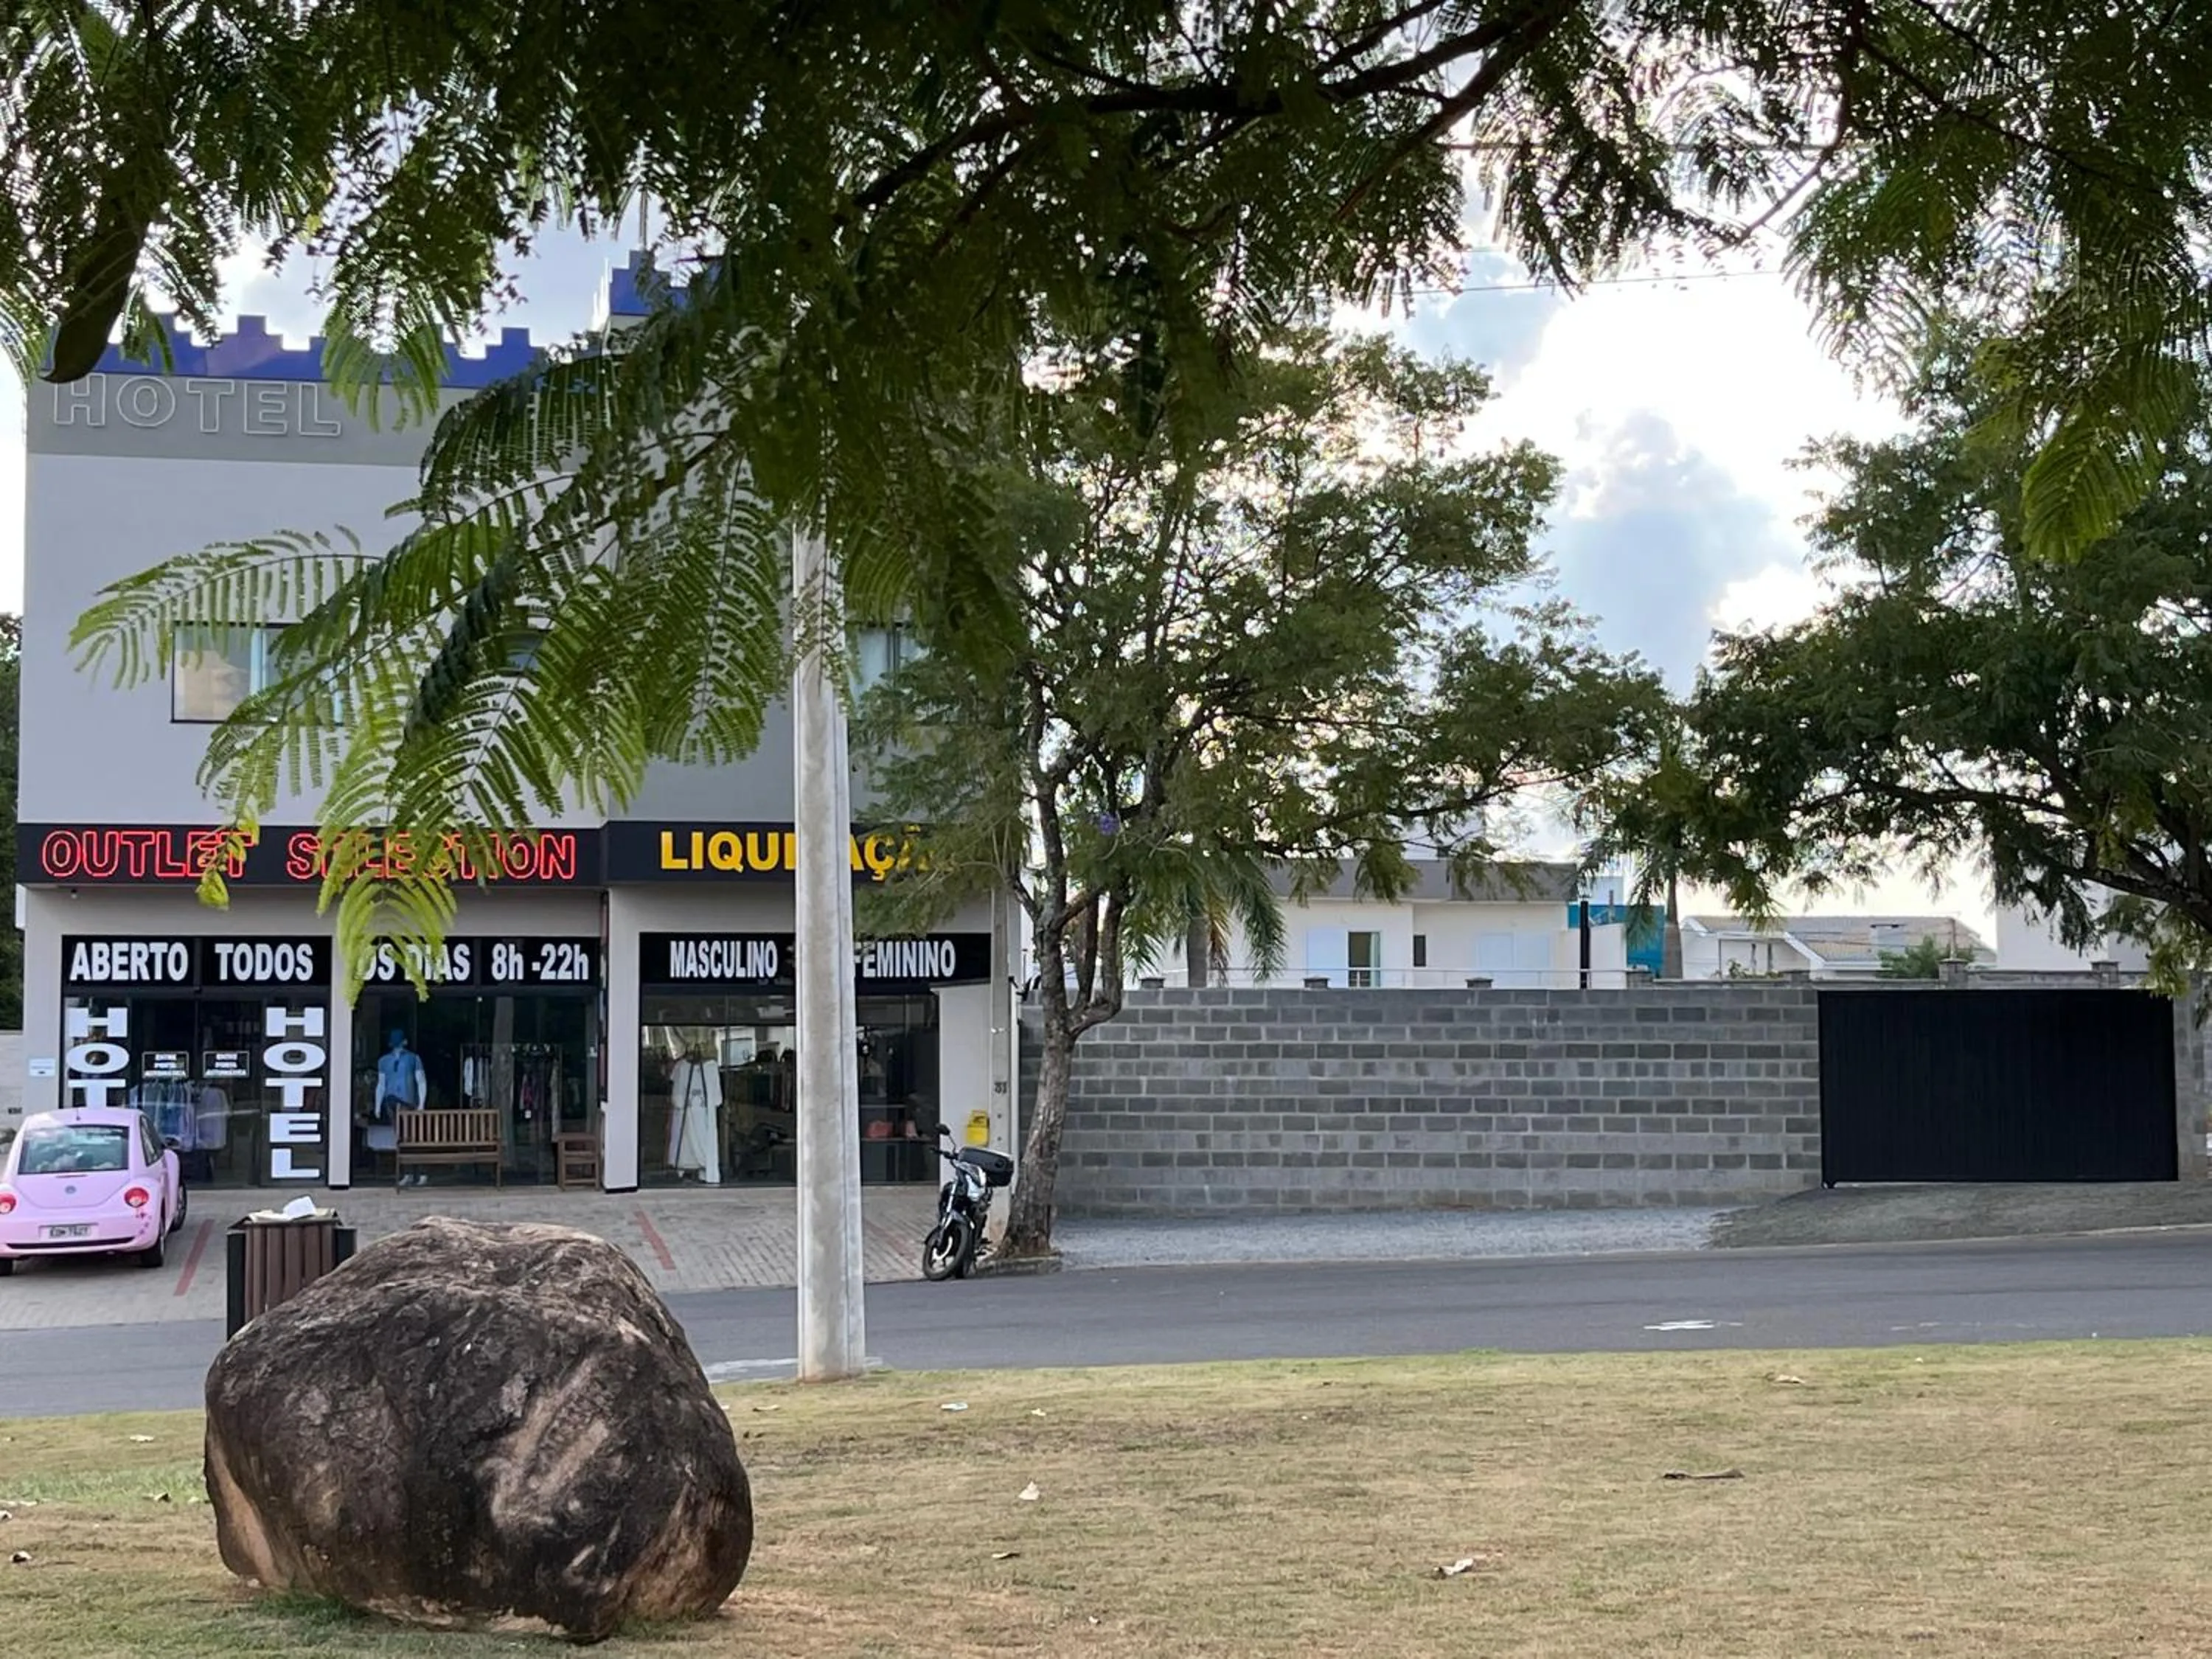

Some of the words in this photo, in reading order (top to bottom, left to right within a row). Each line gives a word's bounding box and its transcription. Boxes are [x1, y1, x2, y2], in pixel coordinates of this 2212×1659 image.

[54, 372, 341, 437] HOTEL
[42, 830, 255, 878] OUTLET
[286, 832, 576, 880] SLETION
[660, 824, 931, 880] LIQUIÇ
[69, 942, 189, 981] ABERTO
[215, 943, 314, 981] TODOS
[404, 943, 471, 981] DIAS
[491, 943, 524, 981] 8h
[669, 940, 779, 979] MASCULINO
[263, 1007, 327, 1178] HOTEL
